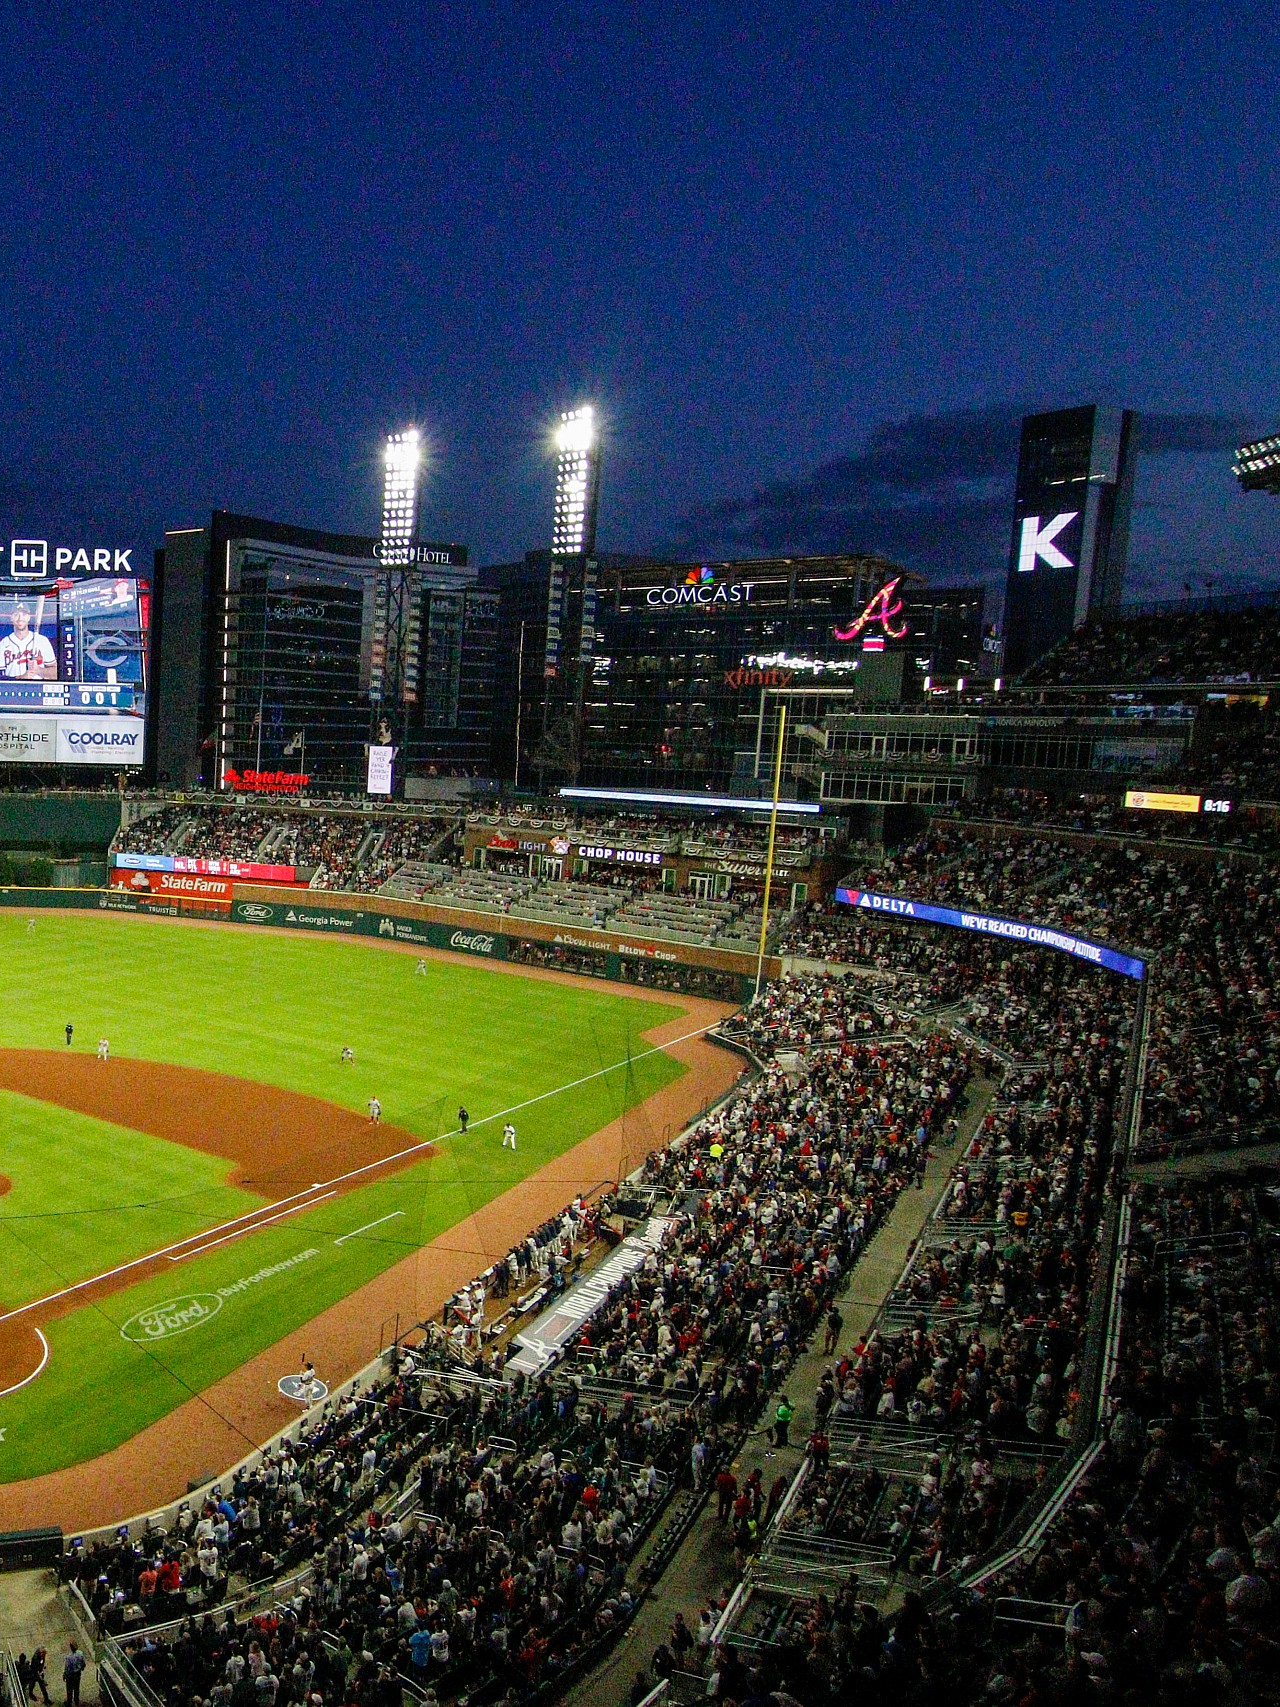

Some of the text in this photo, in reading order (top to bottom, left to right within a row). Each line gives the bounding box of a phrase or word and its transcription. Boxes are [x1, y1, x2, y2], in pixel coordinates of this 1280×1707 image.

[1018, 511, 1079, 572] K
[55, 548, 133, 572] PARK
[416, 547, 452, 564] HOTEL
[646, 584, 754, 605] COMCAST
[723, 666, 795, 689] xfinity
[67, 732, 140, 746] COOLRAY
[1204, 800, 1231, 812] 8:16
[578, 846, 661, 864] CHOP HOUSE
[174, 860, 186, 870] NL
[718, 860, 762, 876] Silver
[149, 906, 169, 914] TRUIST
[243, 905, 268, 918] Ford
[872, 896, 915, 915] DELTA
[961, 914, 988, 931] WE'VE
[988, 920, 1028, 938] REACHED
[298, 914, 354, 928] Georgia Power
[588, 940, 611, 950] LIGHT
[618, 944, 646, 956] BELOW
[654, 950, 677, 961] CHOP
[217, 1248, 321, 1298] BuyFordNow.com
[554, 1288, 605, 1320] WORLD
[138, 1299, 210, 1337] Ford
